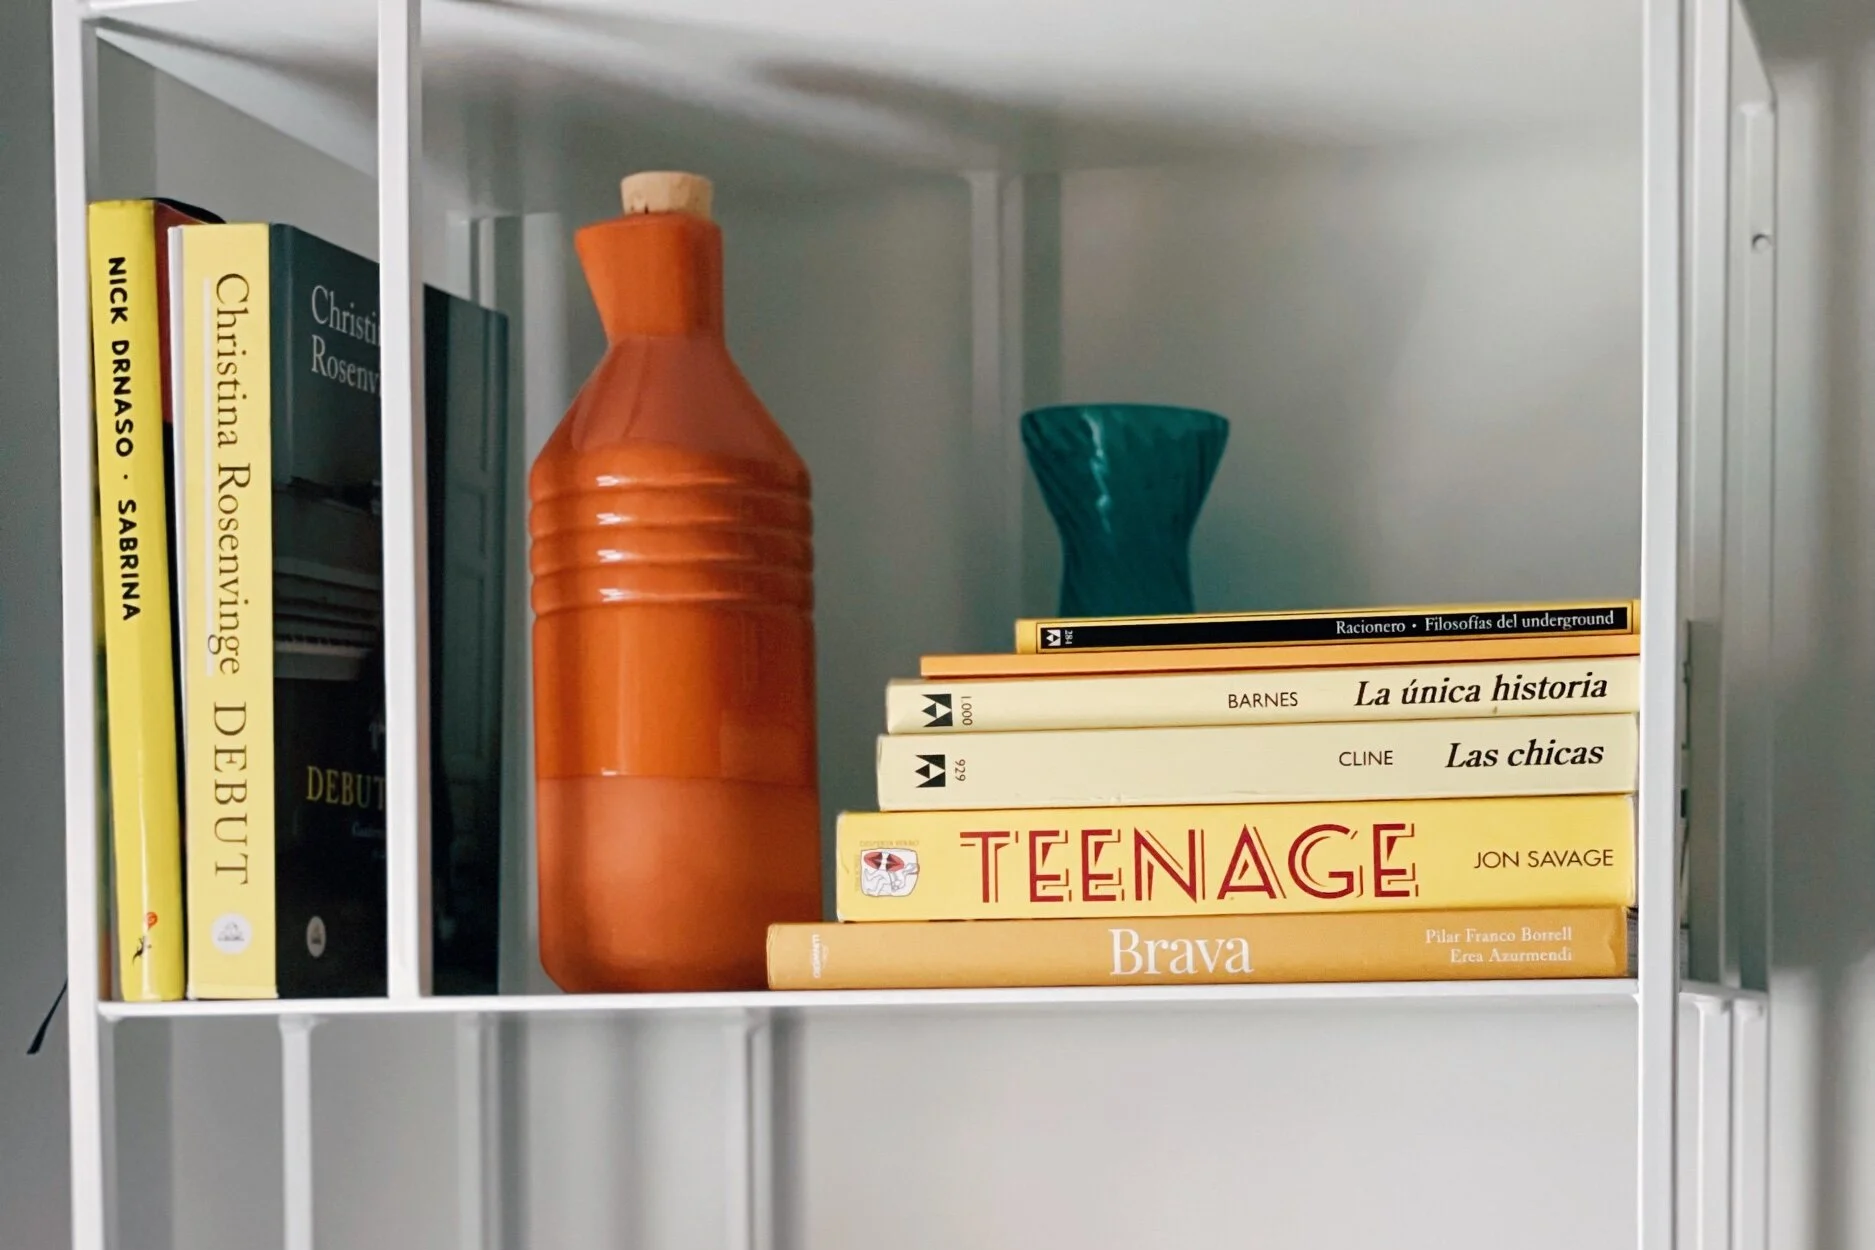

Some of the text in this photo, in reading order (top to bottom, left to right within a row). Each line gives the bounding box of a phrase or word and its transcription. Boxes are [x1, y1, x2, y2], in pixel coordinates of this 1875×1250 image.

[311, 285, 381, 346] Christi
[311, 334, 381, 397] Rosenv
[108, 256, 141, 621] NICK DRNASO SABRINA
[207, 273, 252, 884] Christina Rosenvinge DEBUT
[1335, 619, 1406, 635] Racionero
[1424, 615, 1491, 632] Filosofías
[1496, 613, 1517, 630] del
[1521, 611, 1614, 632] underground
[1228, 691, 1298, 709] BARNES
[1354, 680, 1391, 707] La
[1401, 679, 1481, 706] única
[1492, 672, 1607, 704] historia
[955, 740, 1604, 782] 929 CLINE Las chicas
[960, 823, 1614, 903] TEENAGE JON SAVAGE
[1108, 928, 1253, 977] Brava
[1425, 925, 1572, 946] Pilar Franco Borrell
[1450, 946, 1573, 965] Erea Azurmendi
